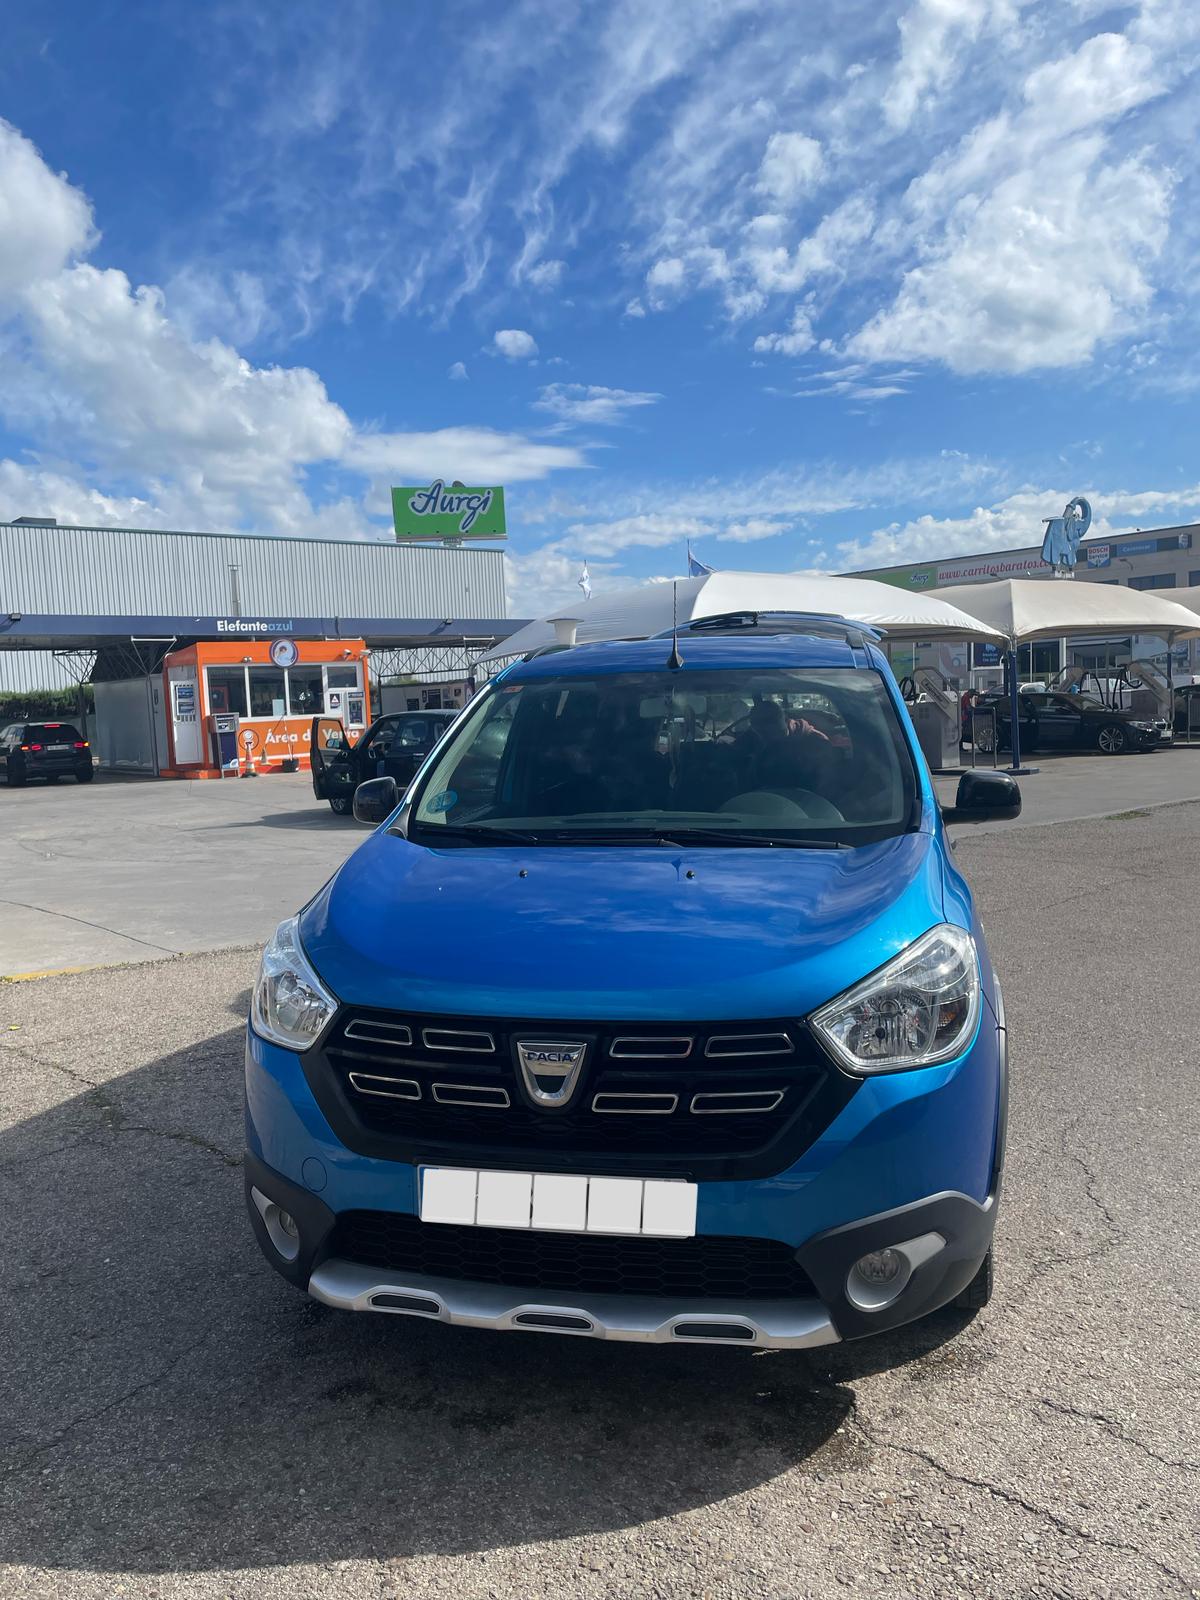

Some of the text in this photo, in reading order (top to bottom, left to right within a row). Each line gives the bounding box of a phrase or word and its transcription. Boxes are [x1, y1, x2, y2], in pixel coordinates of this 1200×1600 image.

[410, 481, 491, 530] Aurgi
[1088, 546, 1109, 554] BOSCH
[265, 728, 298, 743] Área
[302, 728, 312, 741] d
[527, 1052, 572, 1062] DACIA
